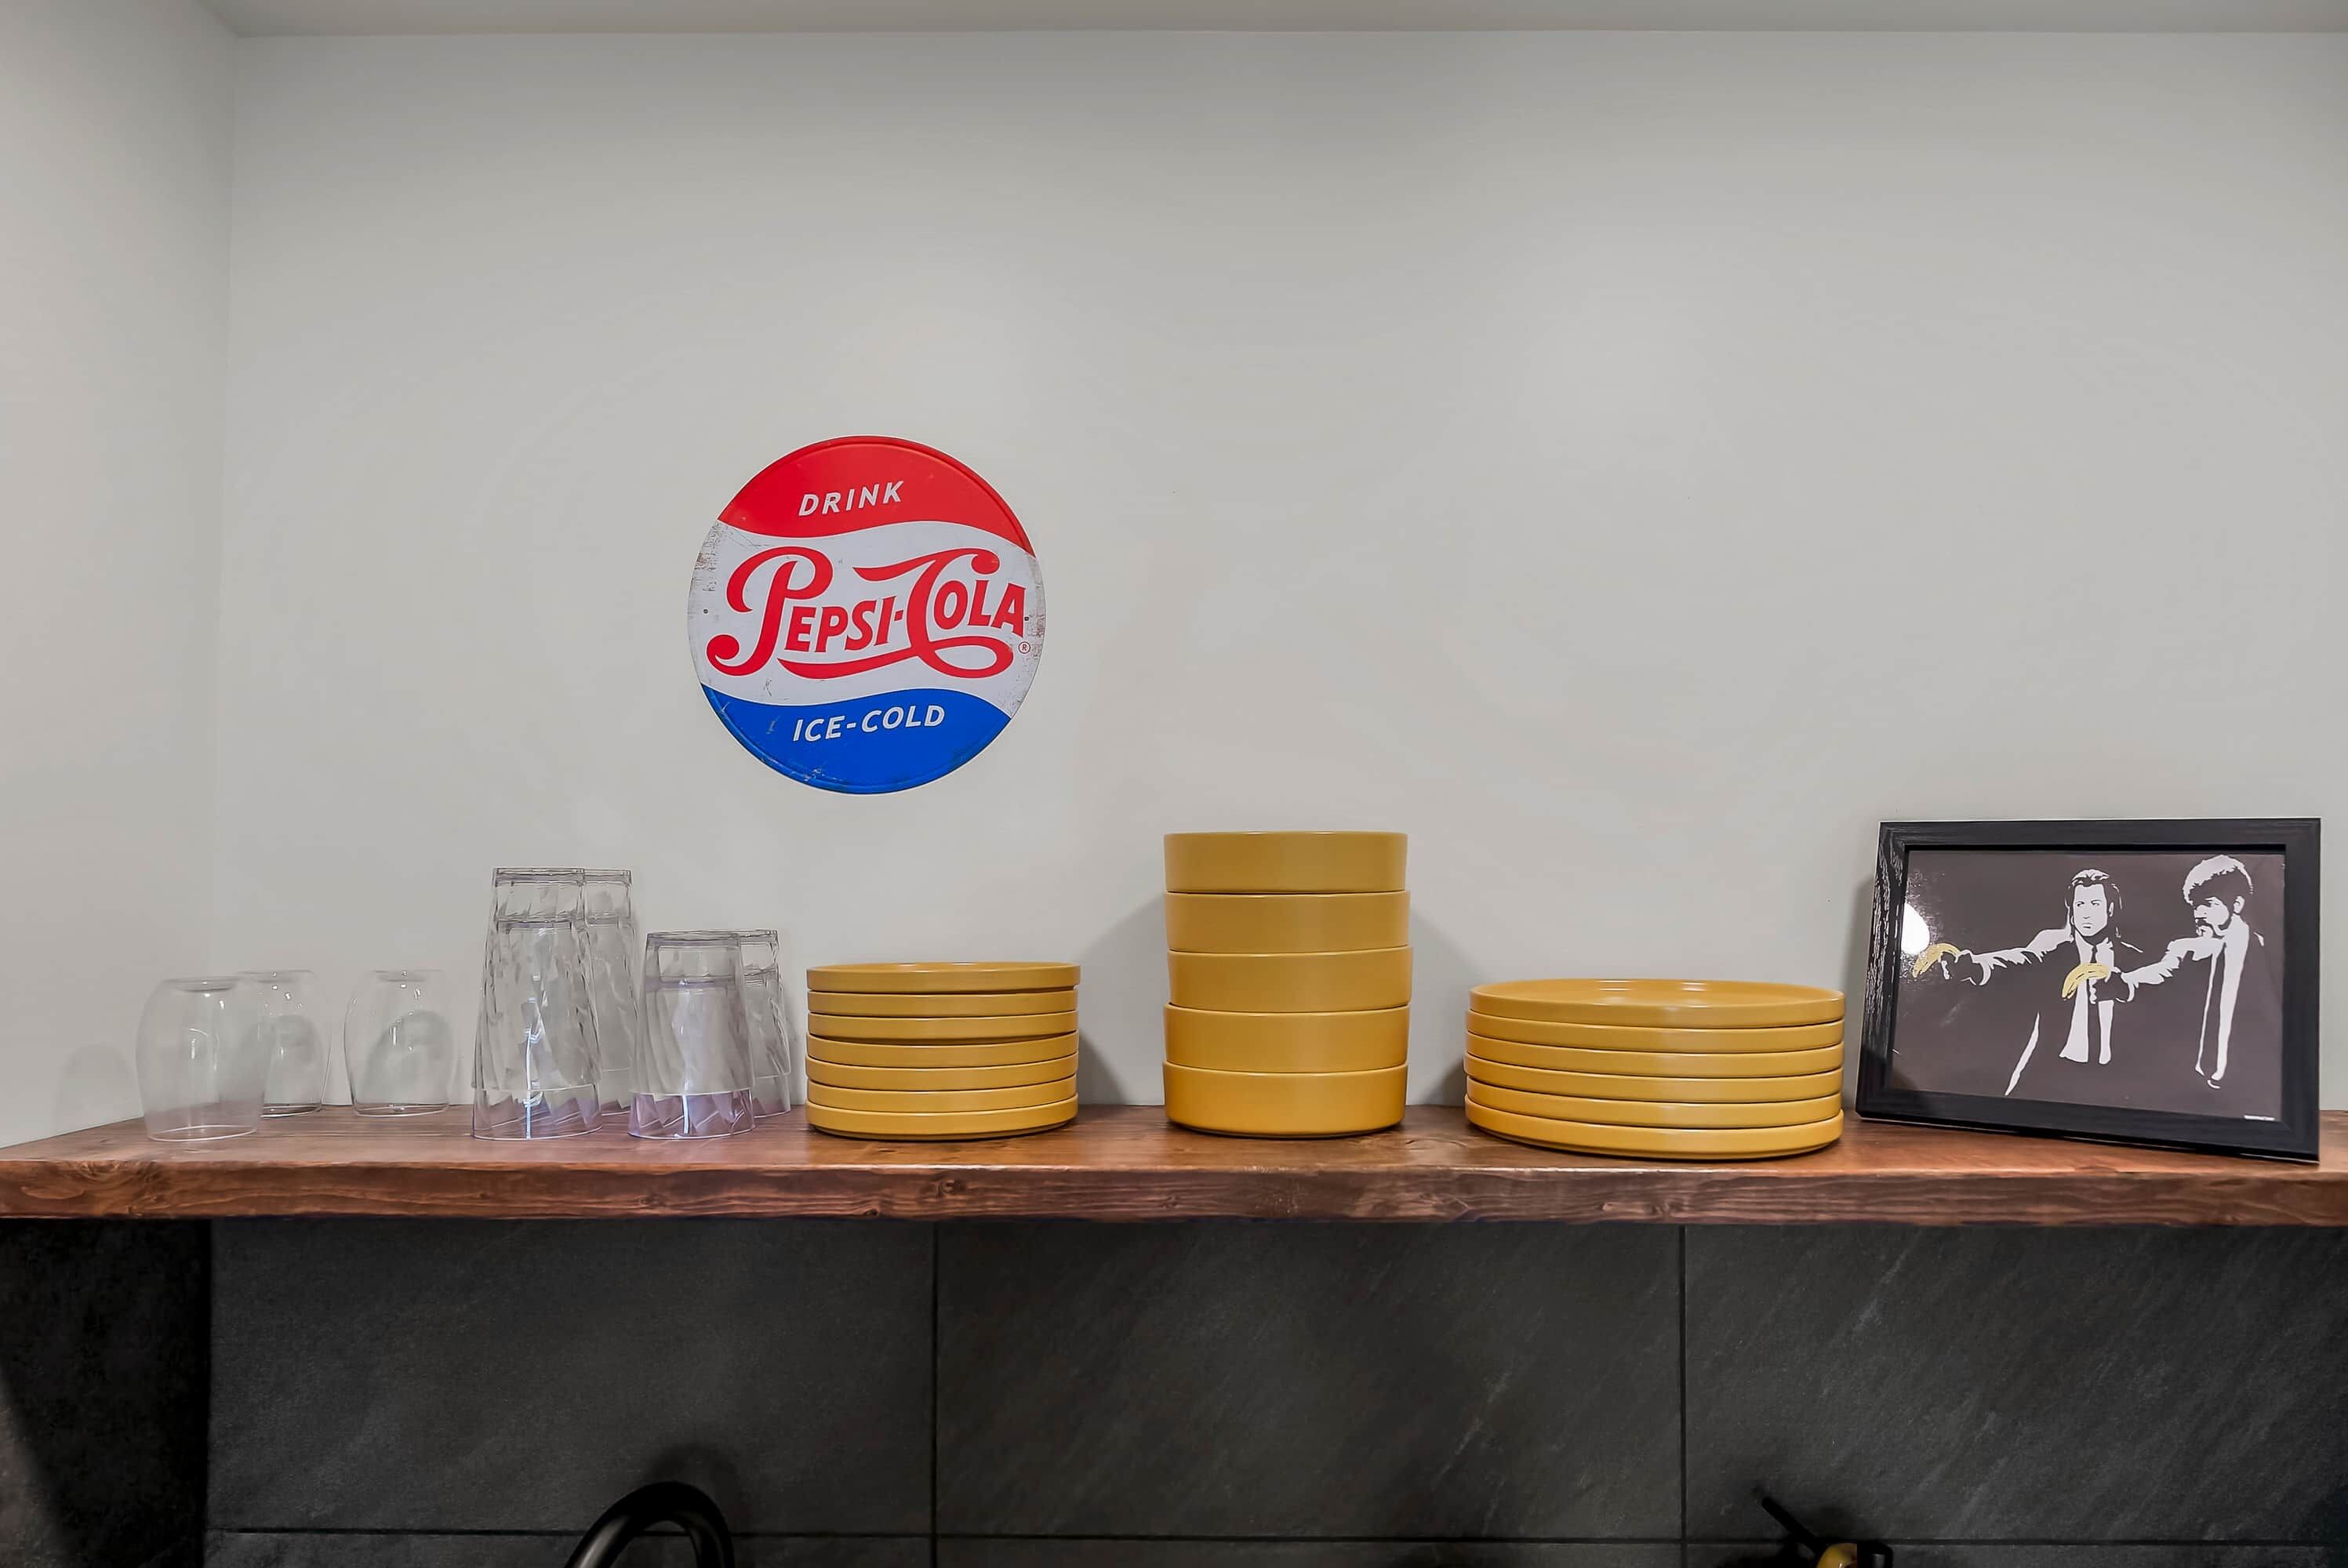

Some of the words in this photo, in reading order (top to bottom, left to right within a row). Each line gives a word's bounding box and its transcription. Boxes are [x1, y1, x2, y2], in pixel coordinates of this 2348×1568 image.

[798, 481, 904, 517] DRINK
[706, 546, 1027, 680] PEPSI-COLA
[793, 705, 946, 742] ICE-COLD
